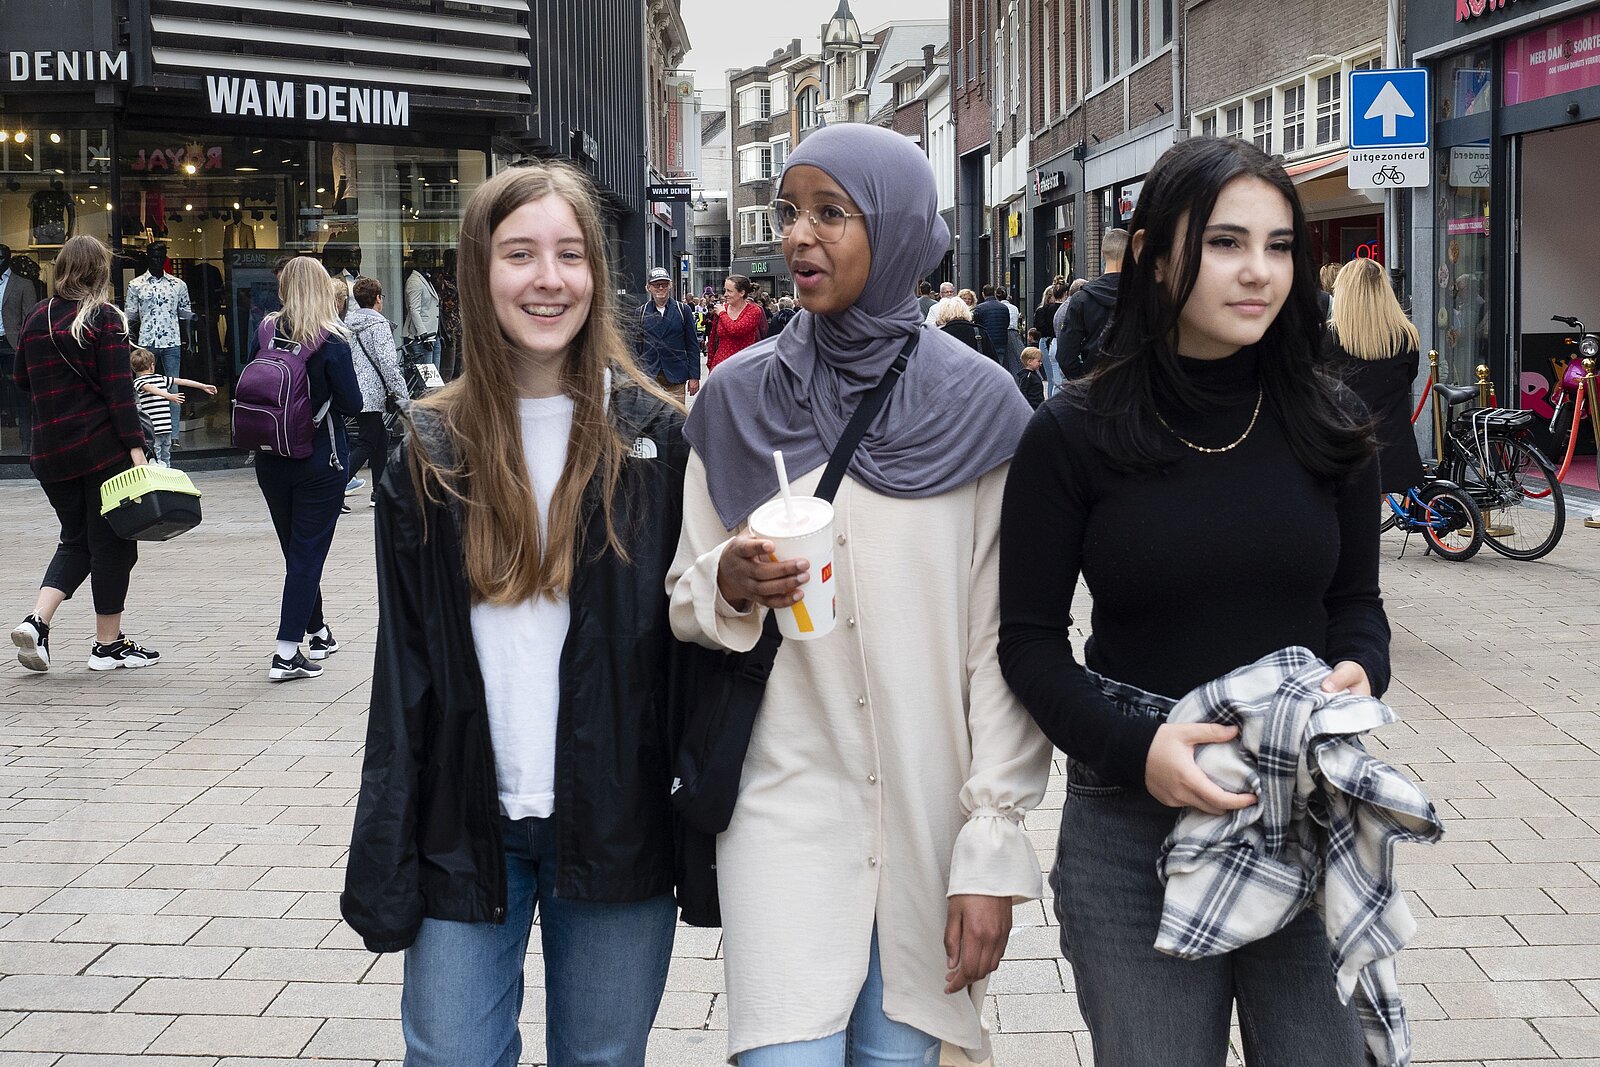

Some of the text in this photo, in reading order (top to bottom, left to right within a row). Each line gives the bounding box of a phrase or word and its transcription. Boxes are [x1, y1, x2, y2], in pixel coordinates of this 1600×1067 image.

[1530, 50, 1547, 66] MEER
[1547, 44, 1563, 61] DAN
[9, 51, 128, 81] DENIM
[206, 75, 409, 127] WAM DENIM
[1352, 151, 1425, 163] uitgezonderd
[652, 187, 690, 195] WAM DENIM
[242, 254, 266, 263] JEANS
